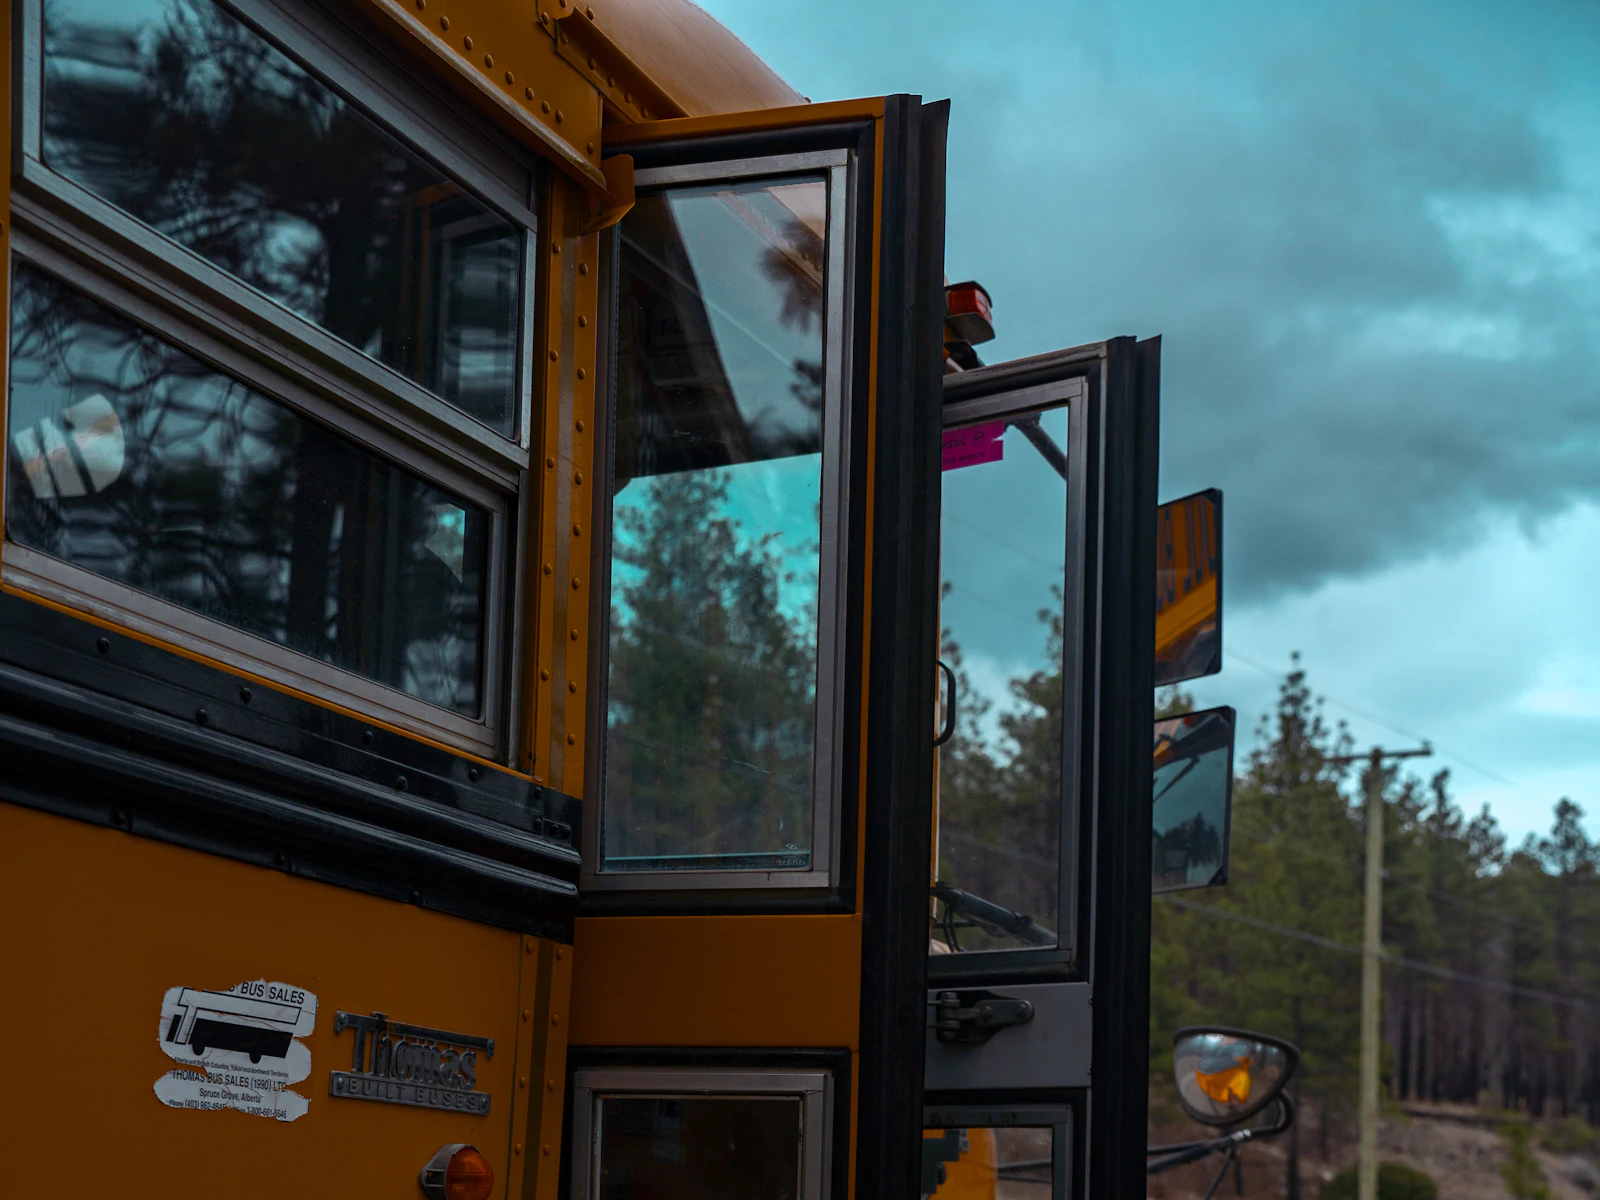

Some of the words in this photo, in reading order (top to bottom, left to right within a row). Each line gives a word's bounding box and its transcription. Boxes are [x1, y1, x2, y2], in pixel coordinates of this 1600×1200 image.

[240, 981, 263, 997] BUS
[268, 986, 305, 1005] SALES
[335, 1010, 494, 1091] Thomas
[172, 1068, 206, 1083] THOMAS
[207, 1072, 224, 1085] BUS
[225, 1074, 249, 1088] SALES
[250, 1077, 272, 1092] (1990)
[273, 1080, 289, 1094] LTD.
[348, 1077, 406, 1101] BUILT
[415, 1087, 476, 1110] BUSES
[169, 1099, 184, 1107] Phone
[185, 1098, 200, 1110] (403)
[199, 1087, 220, 1100] Spruce
[221, 1090, 240, 1102] Grove,
[241, 1092, 262, 1104] Alberta
